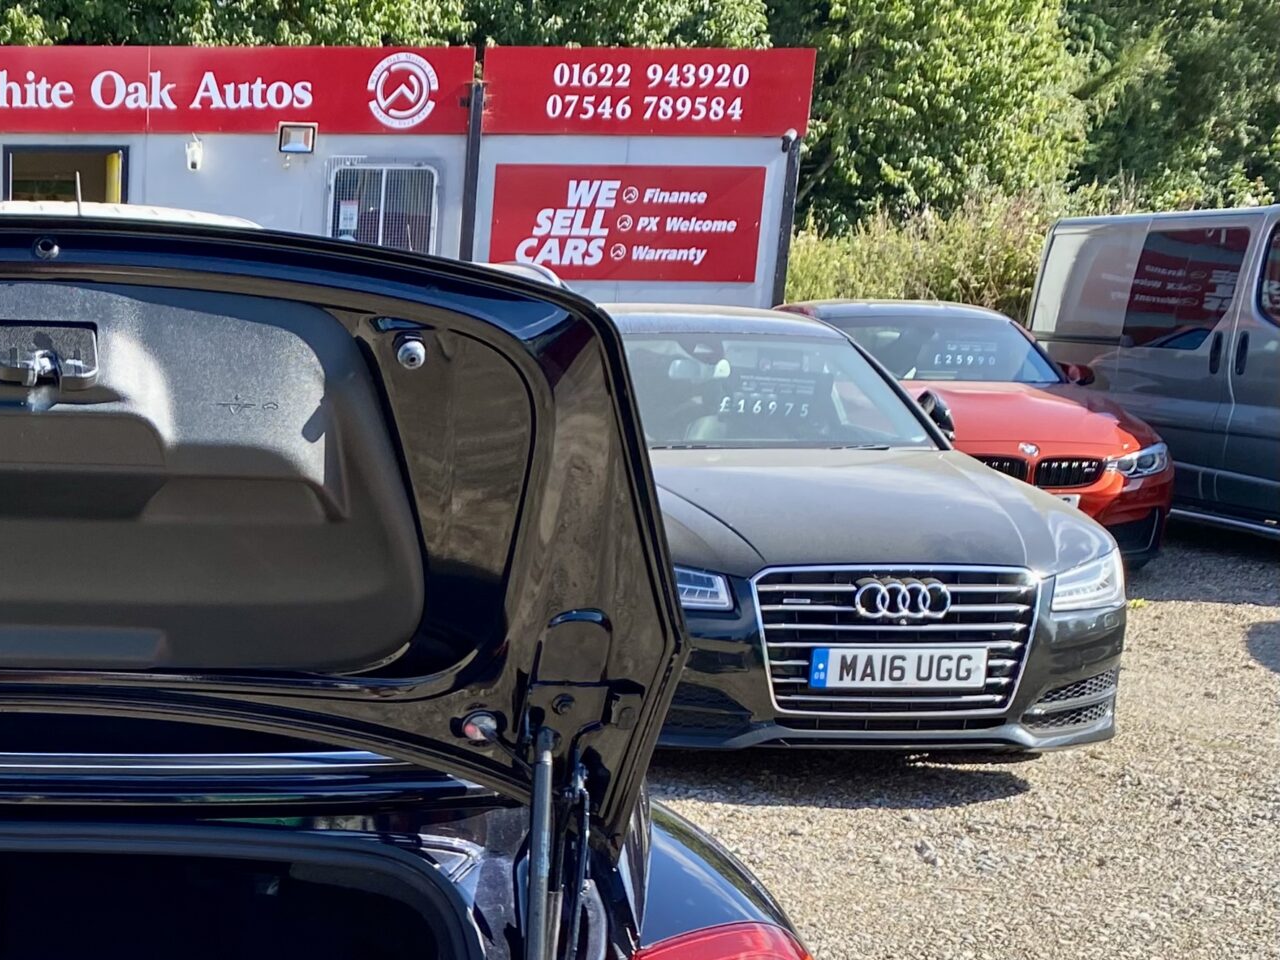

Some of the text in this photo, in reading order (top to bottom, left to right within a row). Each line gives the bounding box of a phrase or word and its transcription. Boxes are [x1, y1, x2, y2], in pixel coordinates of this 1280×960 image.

[553, 63, 750, 88] 01622 943920
[91, 70, 176, 111] Oak
[190, 71, 313, 110] Autos
[546, 94, 744, 121] 07546 789584
[567, 180, 621, 208] WE
[643, 188, 707, 204] Finance
[532, 208, 609, 236] SELL
[637, 216, 737, 233] PX Welcome
[515, 237, 606, 266] CARS
[632, 246, 707, 265] Warranty
[838, 654, 973, 682] MA16 UGG
